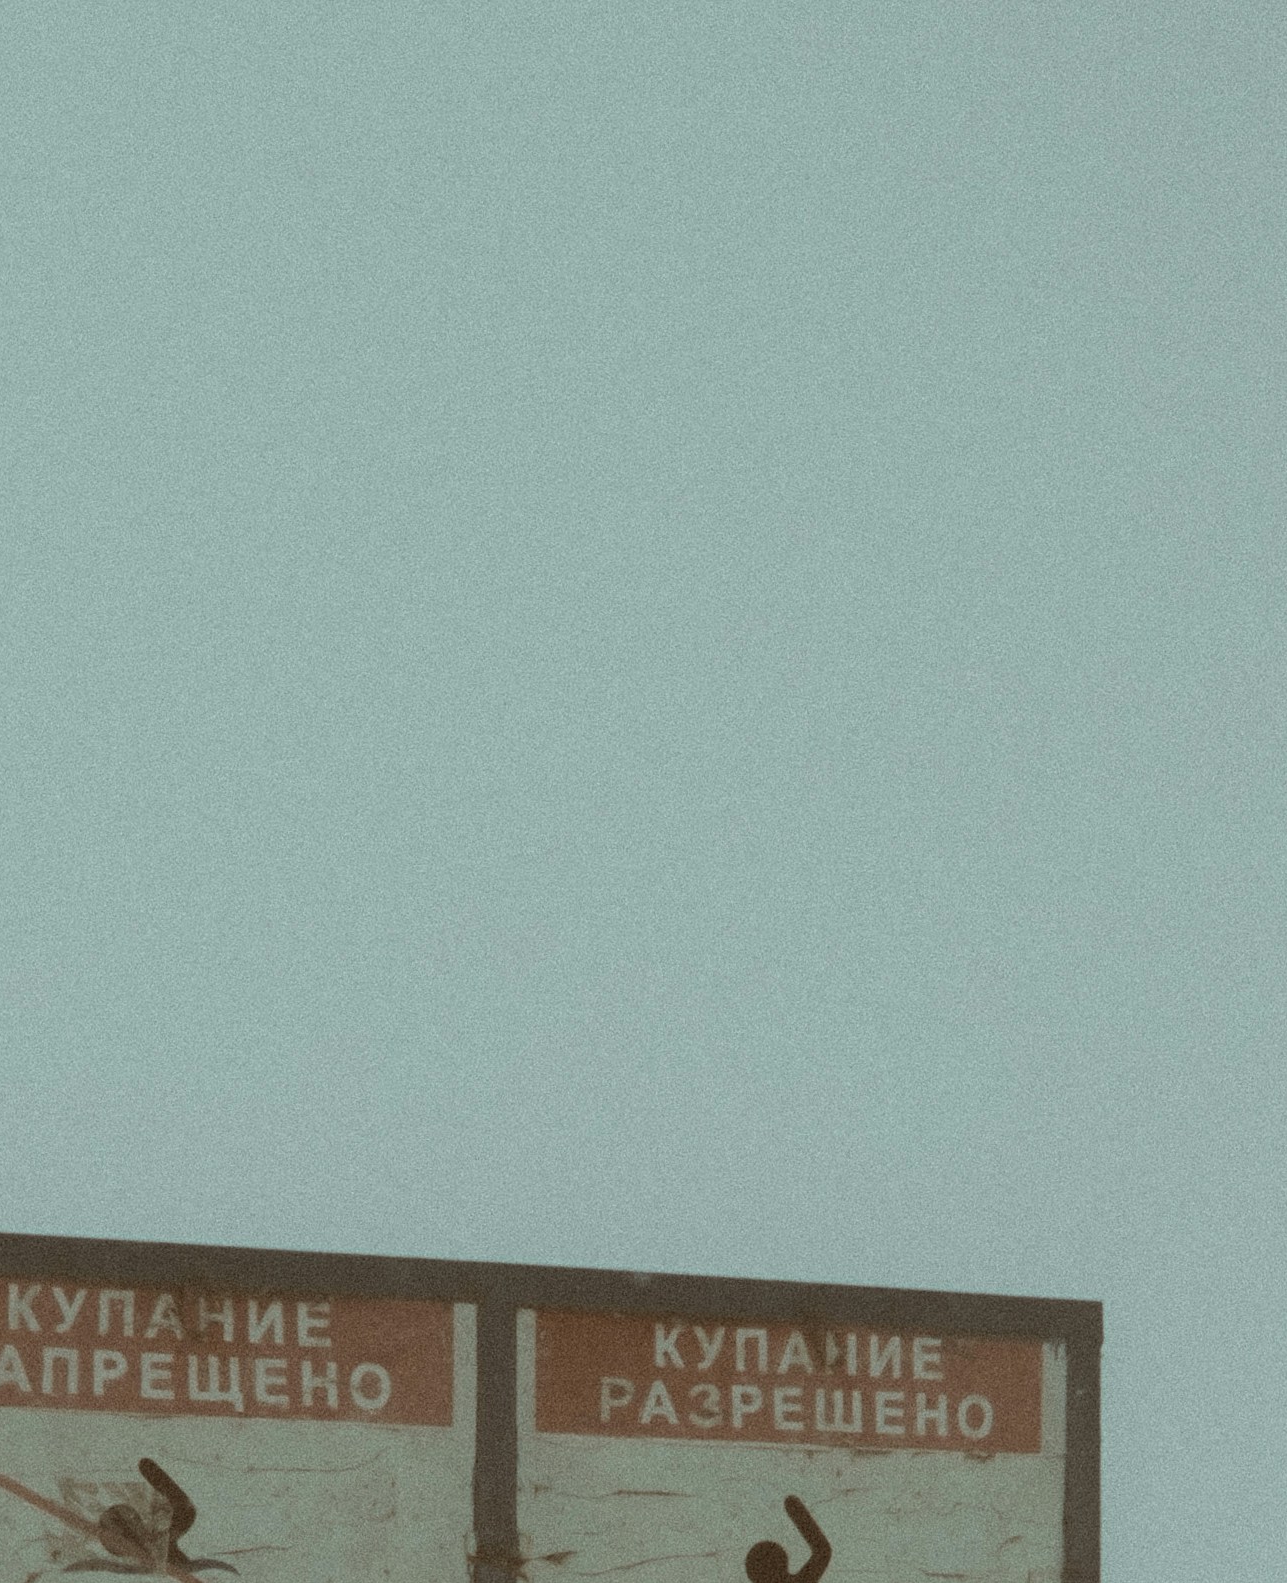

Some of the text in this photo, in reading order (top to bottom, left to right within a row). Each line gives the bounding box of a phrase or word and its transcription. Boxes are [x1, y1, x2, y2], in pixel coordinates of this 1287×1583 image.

[6, 1284, 333, 1348] КУПАНИЕ
[654, 1323, 943, 1381] КУПАНИЕ
[600, 1377, 994, 1439] РАЗРЕШЕНО
